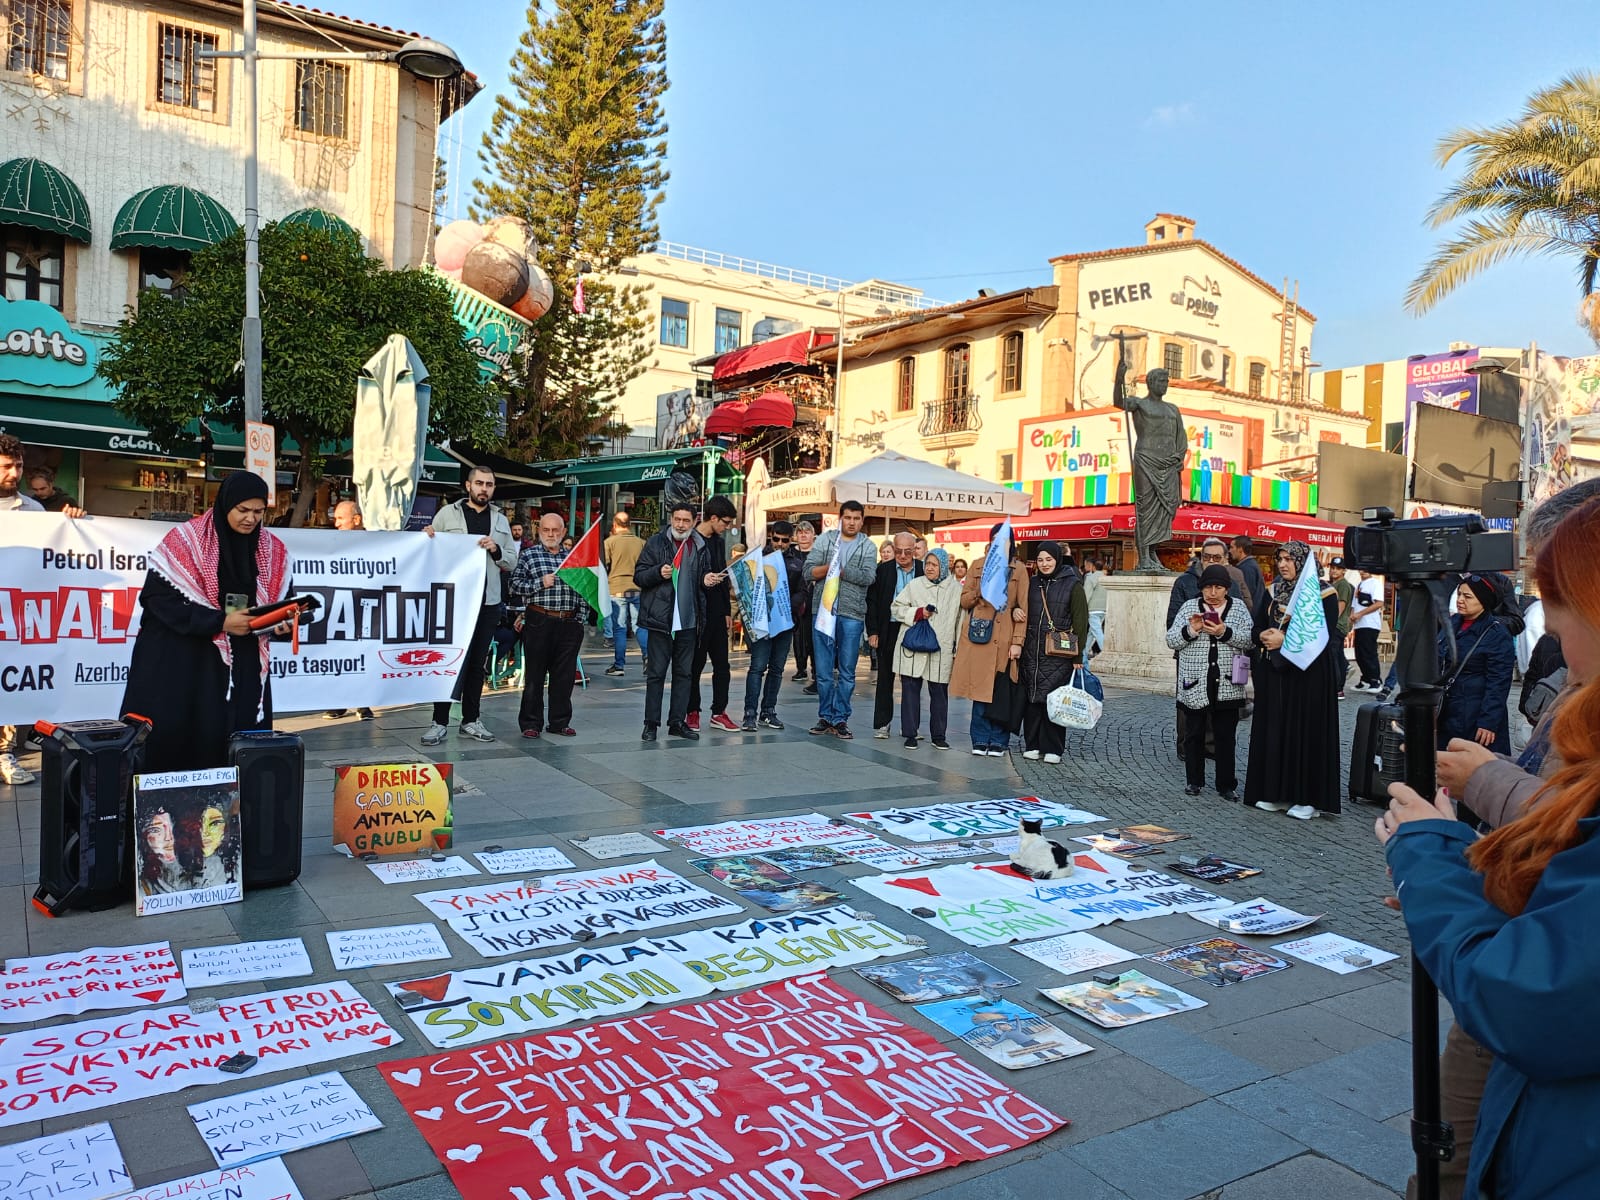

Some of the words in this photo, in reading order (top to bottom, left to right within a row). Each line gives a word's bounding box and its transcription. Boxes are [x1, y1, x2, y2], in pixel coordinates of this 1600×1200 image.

[1089, 282, 1153, 310] PEKER
[1412, 358, 1469, 377] GLOBAL
[772, 491, 780, 501] LA
[780, 487, 817, 501] GELATERIA
[877, 487, 896, 499] LA
[903, 489, 995, 506] GELATERIA
[42, 547, 103, 570] Petrol
[292, 558, 325, 574] ırım
[330, 557, 397, 579] sürüyor!
[75, 661, 129, 684] Azerba
[303, 654, 365, 677] taşıyor!
[357, 764, 432, 789] DİRENİŞ
[354, 810, 436, 830] ANTALYA
[355, 829, 422, 850] GRUBU
[668, 973, 849, 1028] VUSLAT
[23, 1012, 201, 1057] SOCAR
[218, 988, 361, 1024] PETROL
[253, 1001, 378, 1038] DURDUR
[749, 1032, 958, 1095] ERDAL
[455, 1038, 734, 1124] SEYFULLAH
[190, 1079, 343, 1123] LİMANLAR
[213, 1106, 373, 1161] KAPATILSIN
